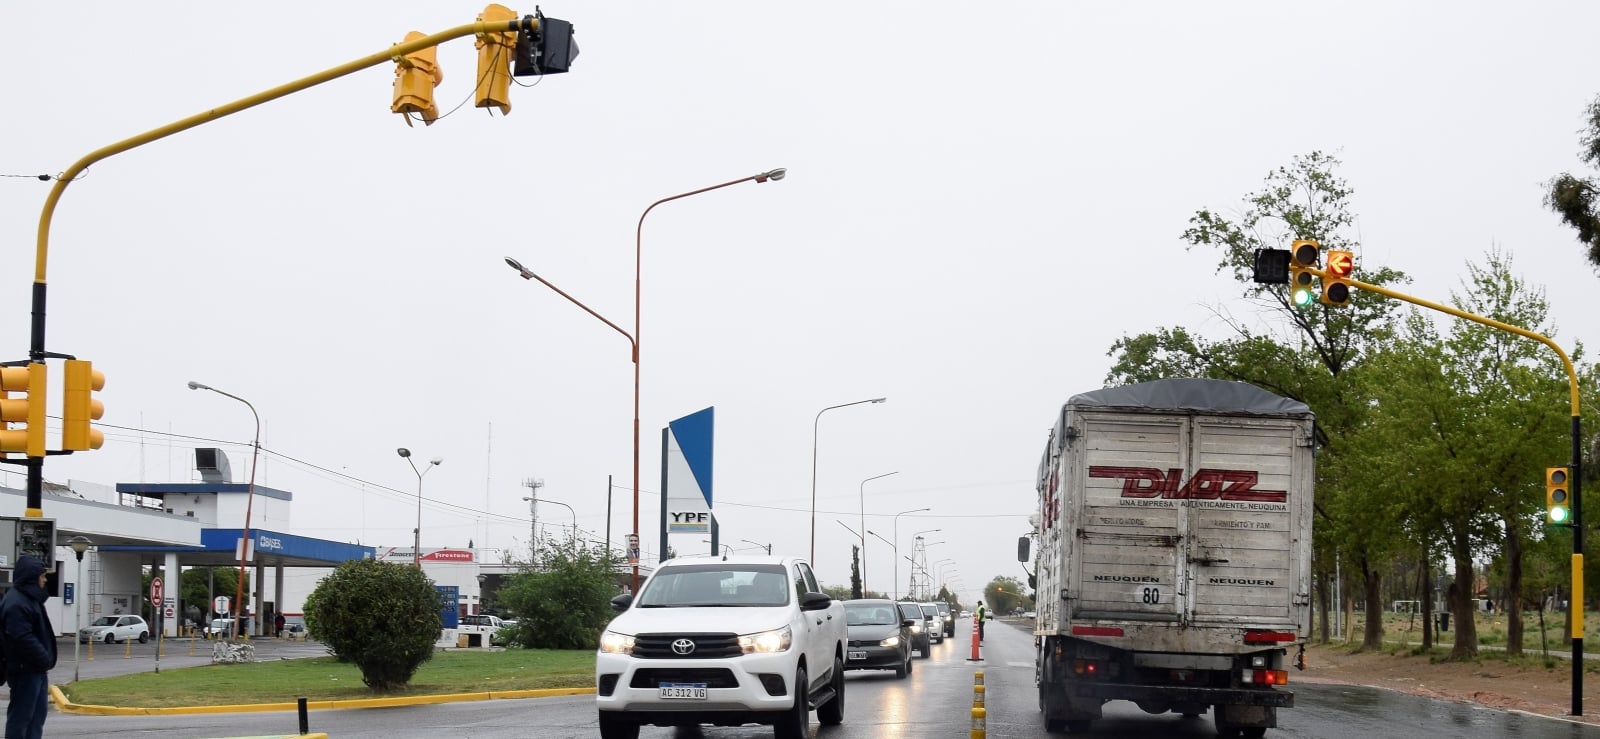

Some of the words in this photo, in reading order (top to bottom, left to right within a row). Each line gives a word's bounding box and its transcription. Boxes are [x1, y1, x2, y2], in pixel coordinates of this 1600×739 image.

[1089, 466, 1287, 503] DIAZ
[1137, 500, 1174, 508] EMPRESA
[1248, 503, 1287, 512] NEUQUINA
[671, 512, 709, 522] YPF
[1209, 577, 1274, 586] NEUQUEN
[1142, 587, 1160, 605] 80
[662, 688, 673, 697] AC
[675, 688, 692, 697] 312
[694, 688, 705, 698] VG
